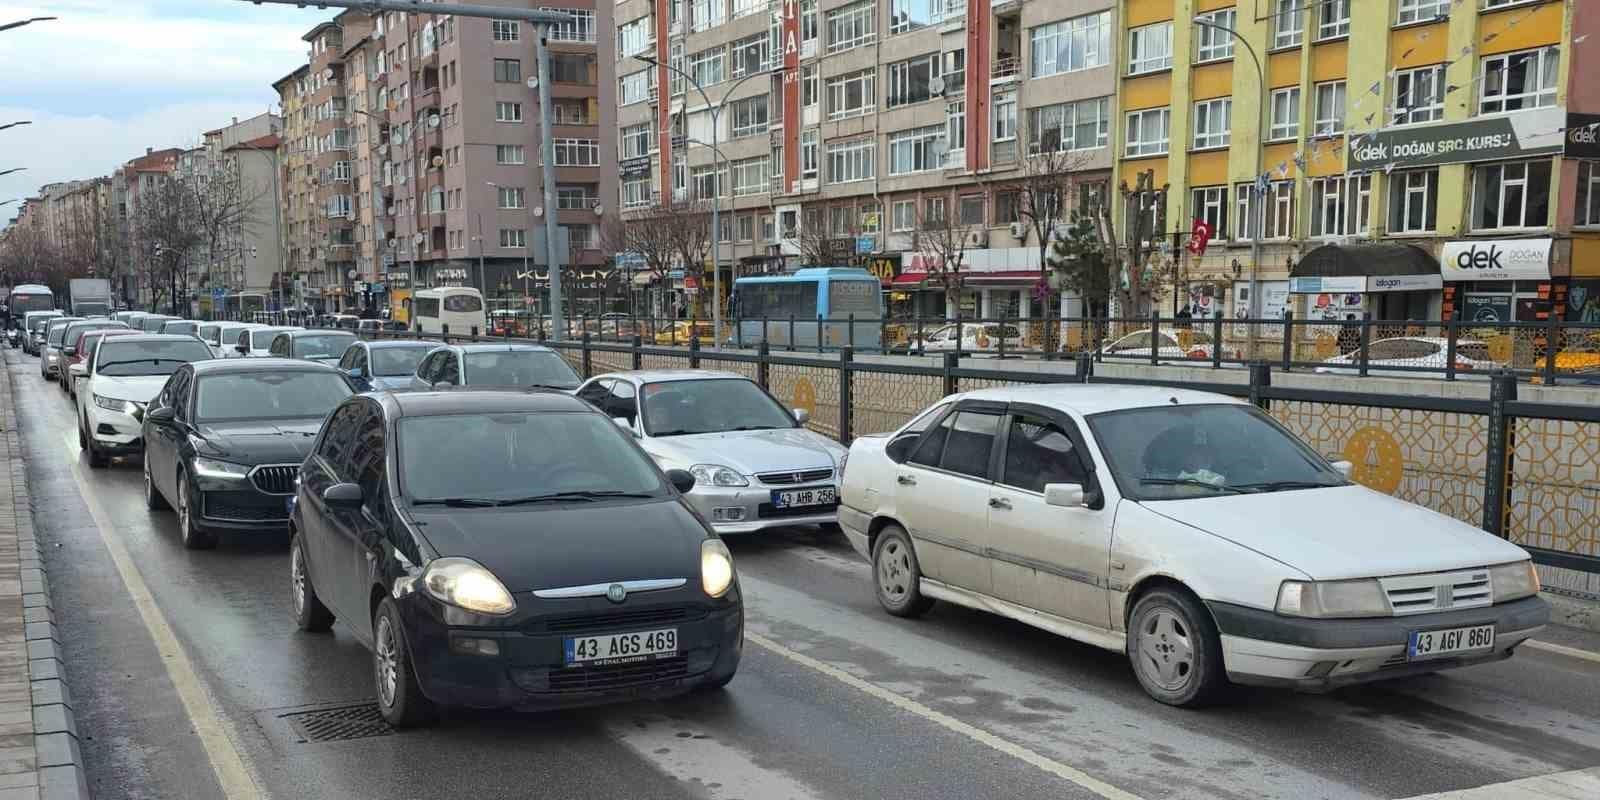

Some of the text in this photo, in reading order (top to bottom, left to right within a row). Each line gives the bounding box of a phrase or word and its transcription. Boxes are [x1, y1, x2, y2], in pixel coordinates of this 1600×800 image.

[1360, 143, 1388, 161] dek
[1393, 140, 1435, 157] DOĞAN
[1466, 133, 1511, 150] KURSU
[1457, 244, 1503, 269] dek
[577, 631, 676, 658] 43 AGS 469
[1416, 627, 1491, 653] 43 AGV 860
